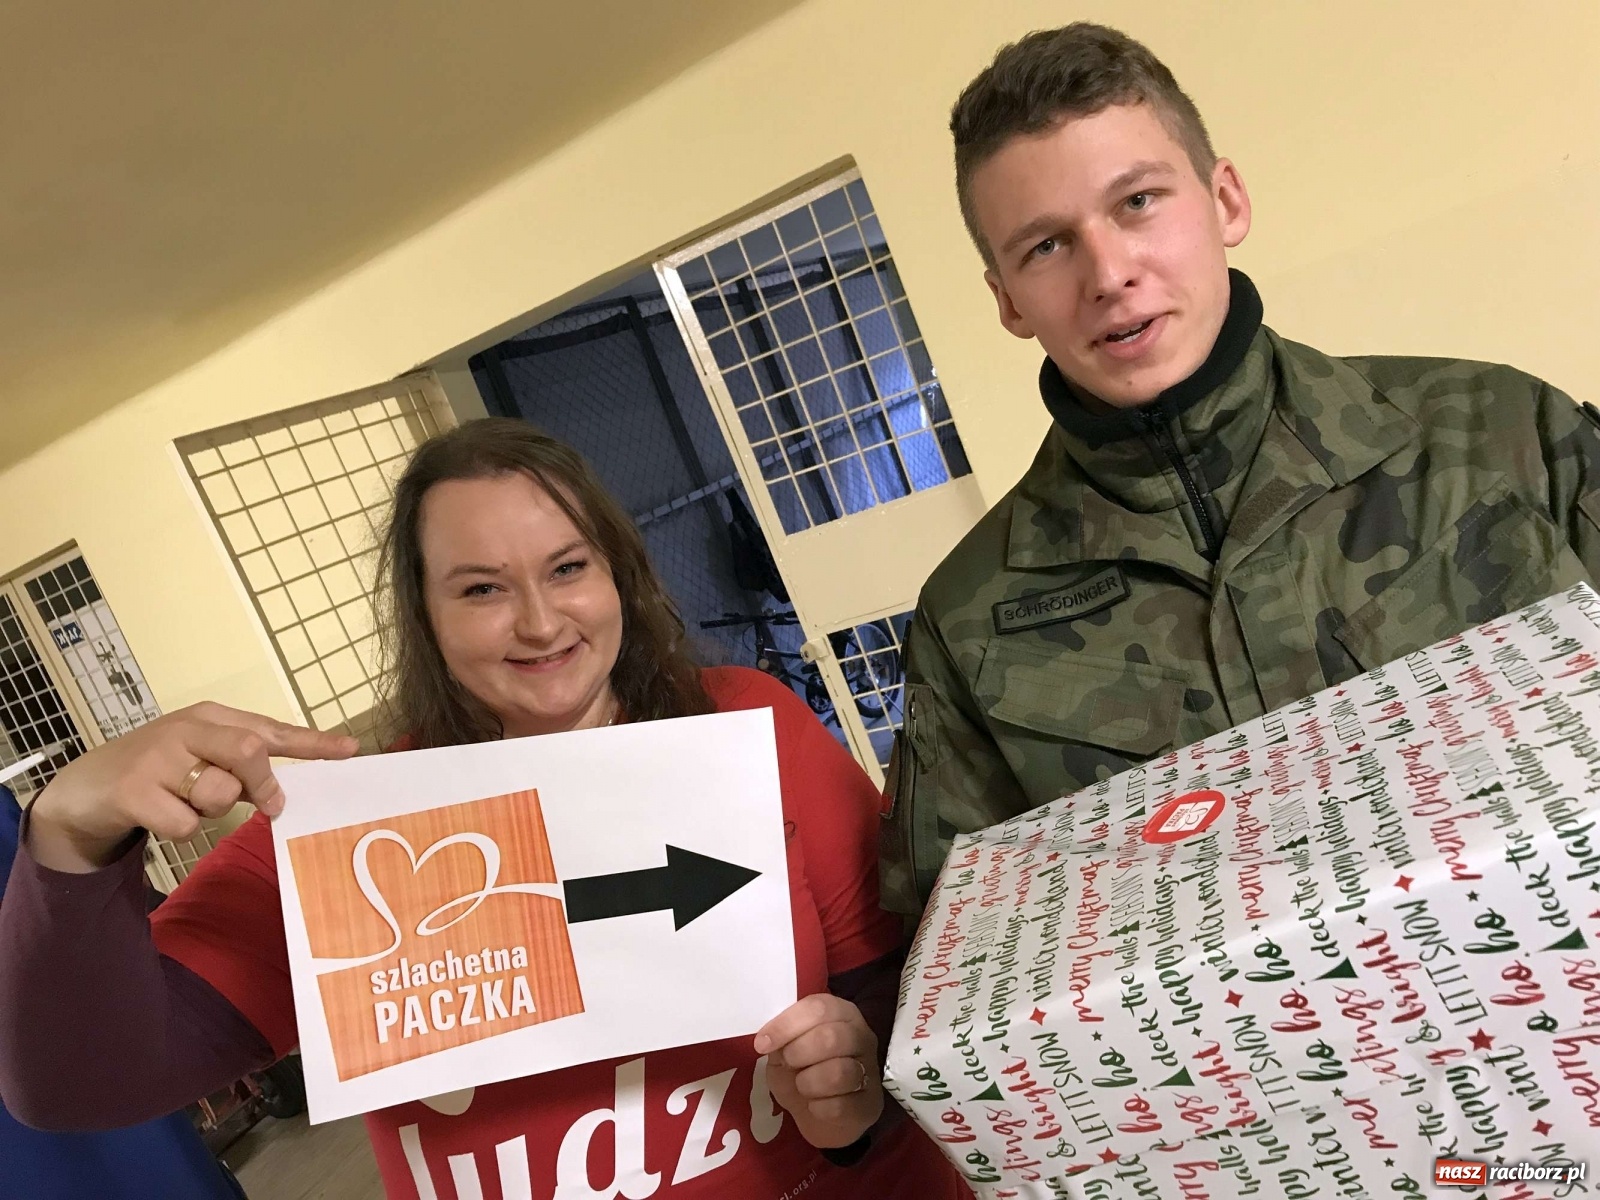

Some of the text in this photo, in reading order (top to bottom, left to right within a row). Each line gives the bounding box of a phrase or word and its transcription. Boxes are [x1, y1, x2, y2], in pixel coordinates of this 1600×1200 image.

[1441, 644, 1474, 664] ho
[1539, 637, 1583, 663] ho
[1552, 653, 1599, 679] ho
[1362, 684, 1399, 707] ho
[1453, 664, 1500, 702] bright
[1368, 700, 1407, 724] ho
[1374, 718, 1415, 741] ho
[1486, 700, 1520, 739] merry
[1214, 733, 1248, 753] ho
[1295, 717, 1333, 754] bright
[1216, 749, 1250, 771] ho
[1216, 767, 1252, 786] ho
[1311, 754, 1341, 789] merry
[1395, 740, 1452, 817] Christmas
[1505, 743, 1564, 803] holidays
[1077, 822, 1109, 844] ho
[1080, 802, 1110, 824] ho
[1228, 788, 1270, 861] Christmas
[1313, 796, 1355, 856] holidays
[1481, 797, 1522, 830] halls
[950, 847, 980, 869] ho
[1369, 818, 1416, 869] winter
[1430, 811, 1483, 881] merry
[1505, 828, 1538, 873] the
[1543, 796, 1600, 881] happy
[944, 868, 975, 889] ho
[1014, 863, 1042, 906] merry
[1181, 831, 1222, 910] wonderland
[1284, 849, 1314, 877] halls
[1332, 852, 1370, 913] happy
[1066, 860, 1110, 949] Christmas
[1146, 874, 1180, 947] holidays
[1237, 860, 1283, 920] merry
[1290, 876, 1318, 909] the
[1525, 862, 1570, 927] deck
[923, 897, 976, 979] Christmas
[989, 914, 1029, 978] holidays
[1190, 908, 1239, 982] winter
[1299, 899, 1340, 958] deck
[1393, 899, 1456, 962] SNOW
[1463, 907, 1520, 954] ho
[370, 946, 528, 994] szlachetna
[1024, 945, 1059, 1002] winter
[1114, 936, 1140, 971] halls
[1245, 937, 1295, 982] ho
[1356, 928, 1426, 1024] bright
[1425, 964, 1469, 988] IT
[958, 968, 982, 1001] halls
[1068, 949, 1114, 1022] merry
[1120, 972, 1147, 1018] the
[1155, 945, 1203, 1025] happy
[1489, 959, 1546, 1006] ho
[374, 975, 537, 1044] PACZKA
[911, 981, 961, 1040] merry
[948, 1002, 976, 1032] the
[982, 976, 1018, 1041] happy
[1270, 988, 1321, 1032] ho
[1439, 988, 1488, 1025] LET
[1527, 1009, 1558, 1033] o
[952, 1024, 989, 1081] deck
[1139, 1007, 1178, 1067] deck
[1225, 1014, 1282, 1073] SNOW
[1296, 1038, 1348, 1081] ho
[910, 1062, 952, 1101] ho
[1030, 1032, 1083, 1088] SNOW
[1091, 1046, 1137, 1088] ho
[1001, 1056, 1062, 1140] bright
[1059, 1090, 1095, 1111] IT
[1192, 1040, 1257, 1128] bright
[1256, 1076, 1294, 1097] IT
[937, 1106, 976, 1143] ho
[1071, 1112, 1113, 1144] LET
[1117, 1093, 1162, 1133] ho
[1416, 1100, 1447, 1146] the
[1445, 1065, 1508, 1153] happy
[962, 1148, 1001, 1182] ho
[1217, 1144, 1260, 1196] halls
